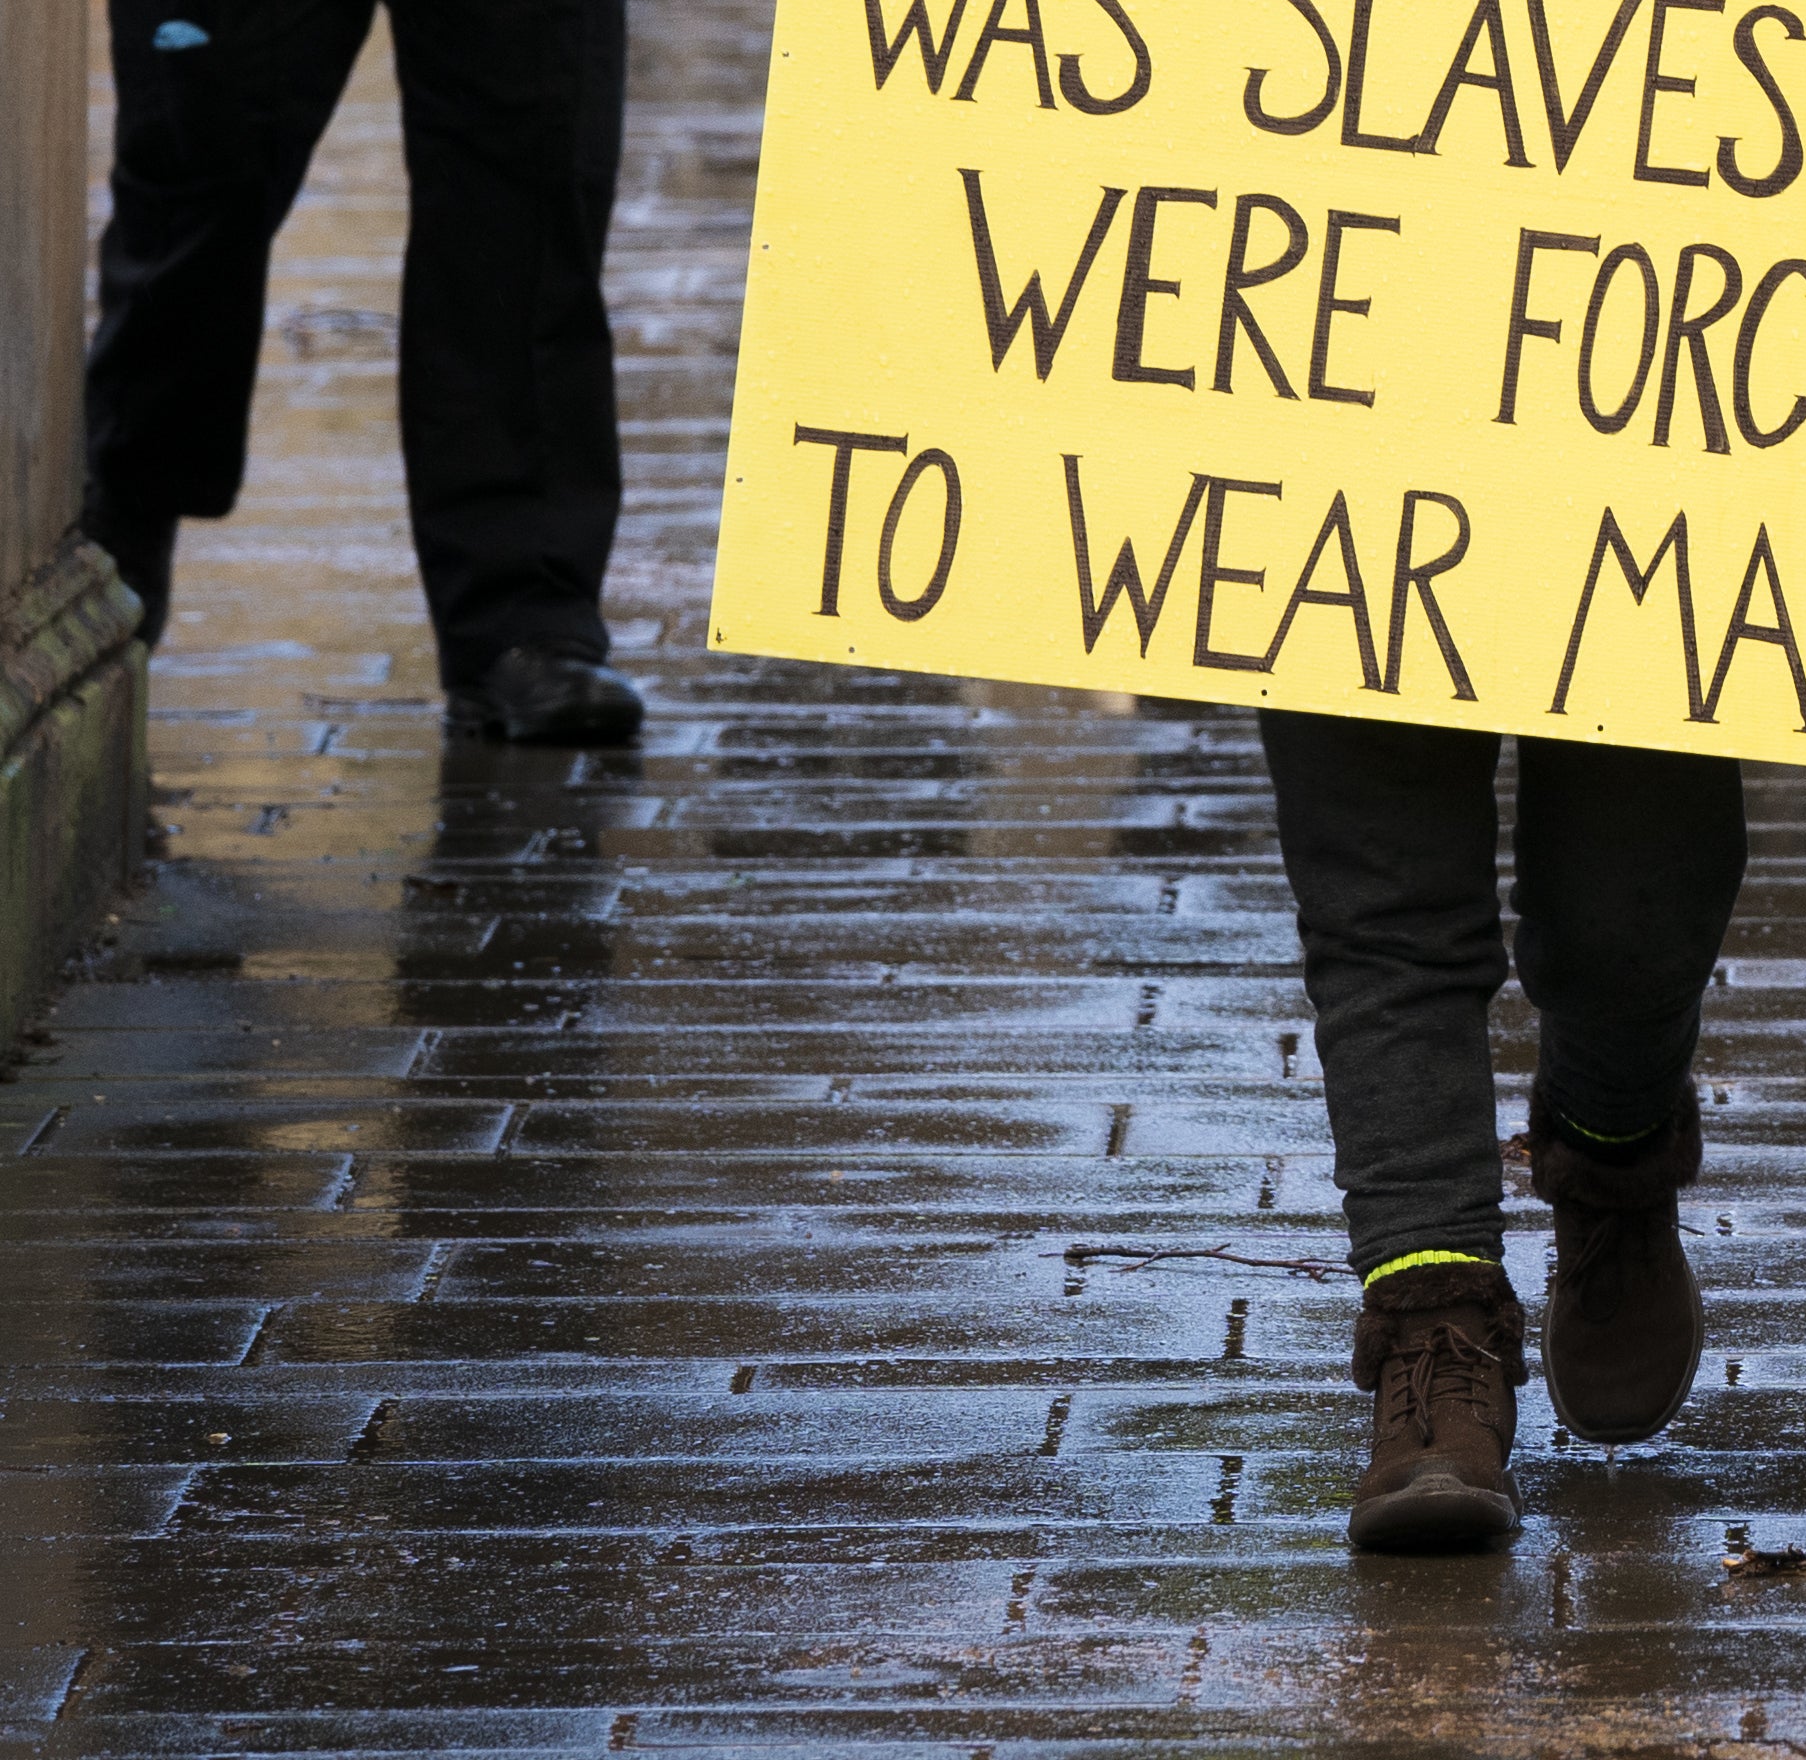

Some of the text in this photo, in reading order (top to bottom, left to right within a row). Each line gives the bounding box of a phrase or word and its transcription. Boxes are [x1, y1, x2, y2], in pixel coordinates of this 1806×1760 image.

[957, 168, 1400, 408] WERE
[794, 423, 962, 621] TO
[1061, 454, 1478, 701] WEAR
